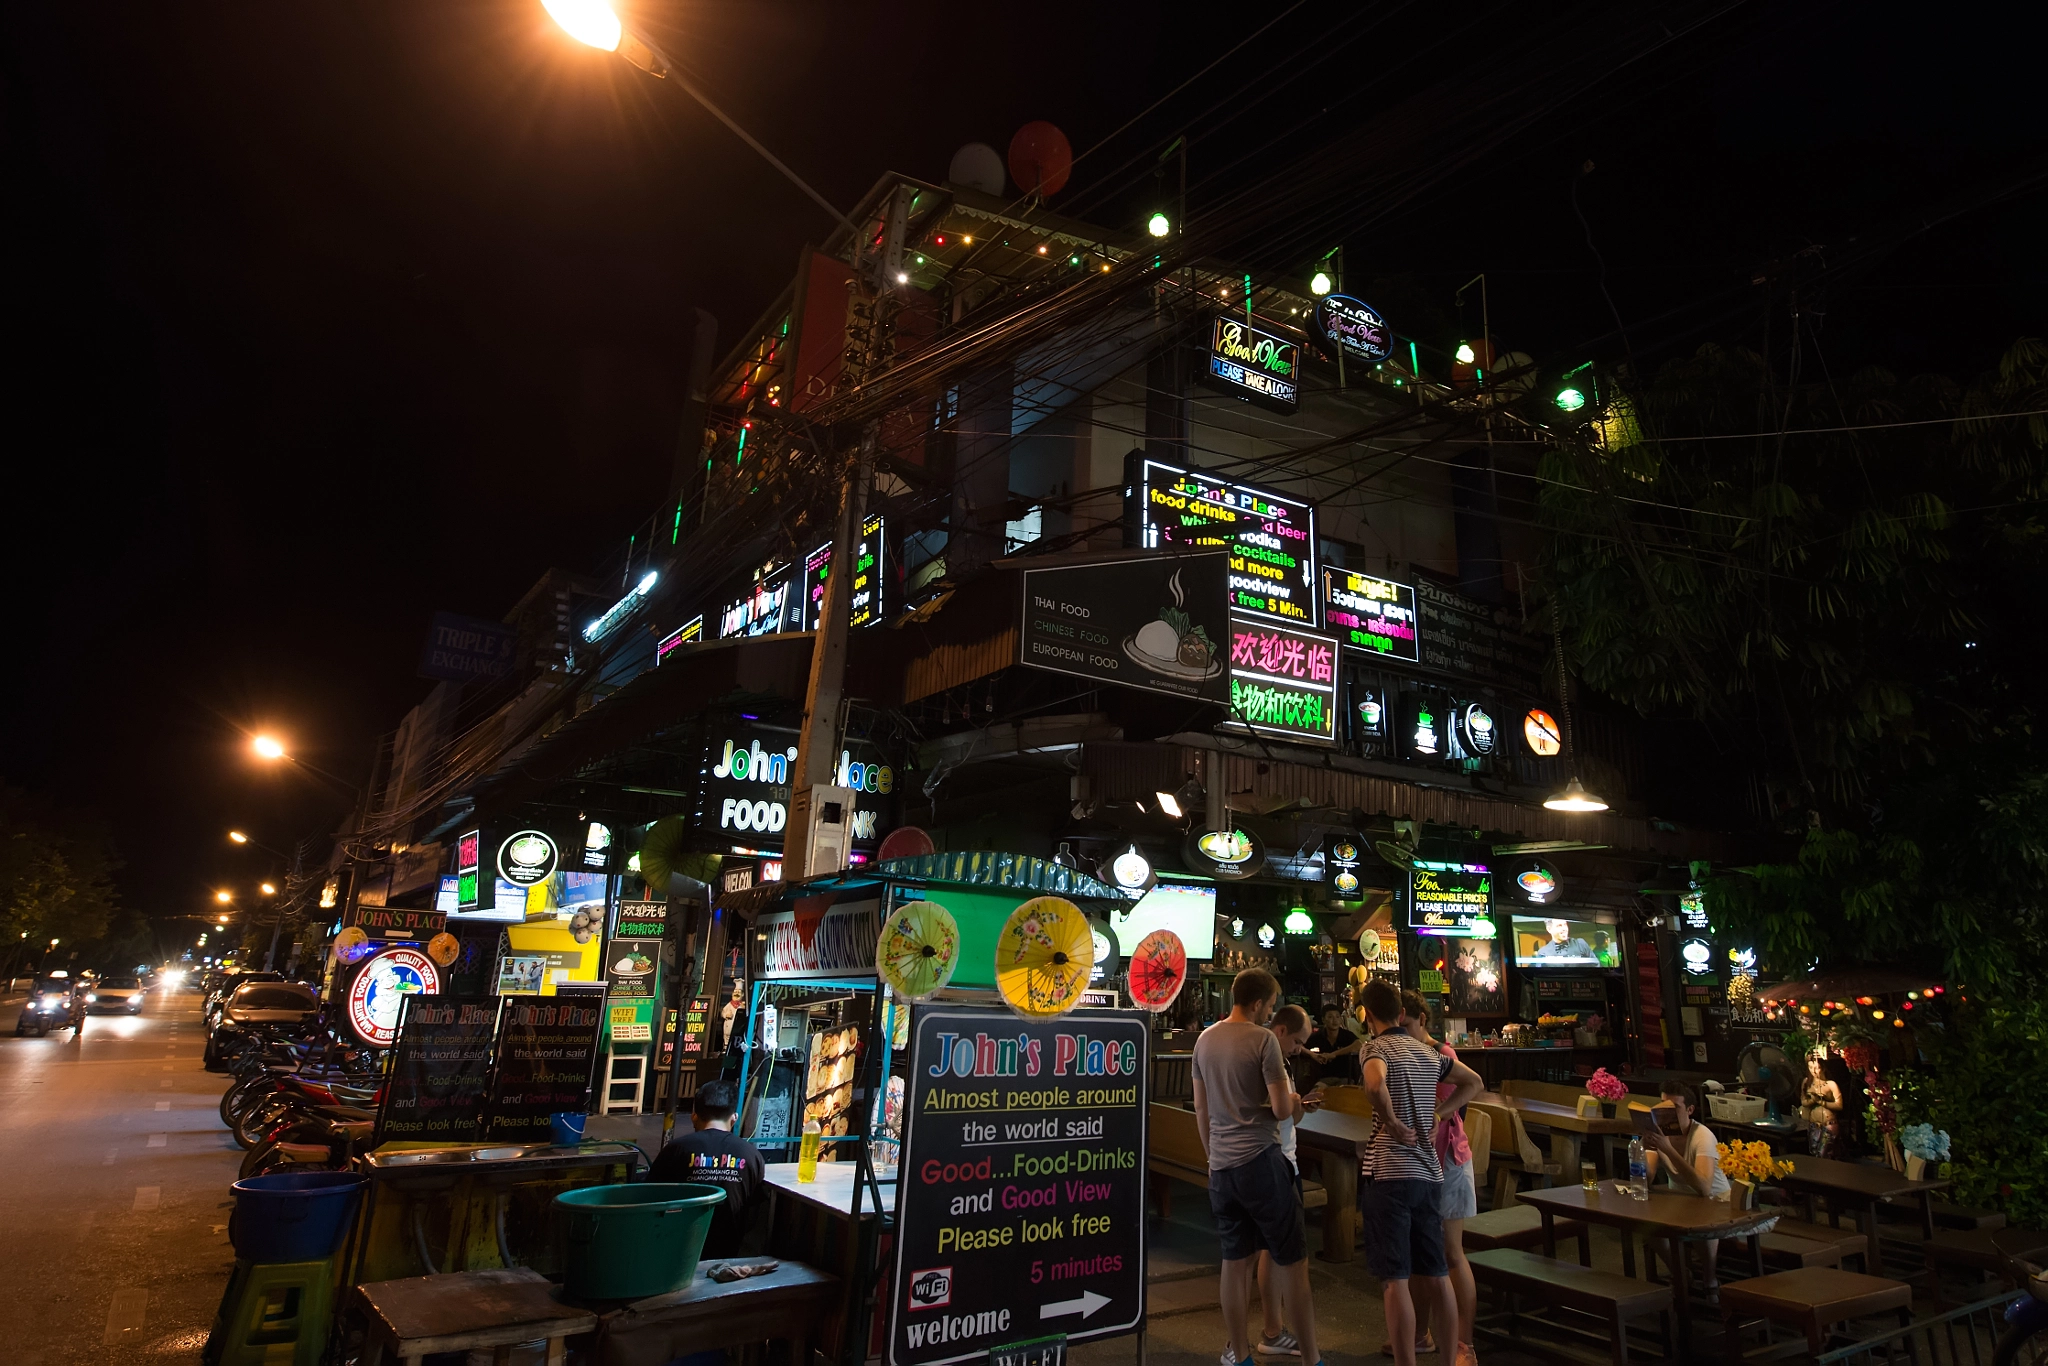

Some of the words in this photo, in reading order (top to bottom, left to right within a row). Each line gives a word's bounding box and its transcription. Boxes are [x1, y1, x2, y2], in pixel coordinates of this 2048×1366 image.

[1357, 324, 1382, 343] View
[1218, 323, 1262, 363] Good
[1258, 339, 1292, 375] View
[1212, 359, 1244, 383] PLEASE
[1244, 370, 1265, 391] TAKE
[1265, 380, 1272, 394] A
[1272, 381, 1295, 401] LOOK
[1150, 488, 1186, 509] food
[1189, 500, 1236, 522] drinks
[1173, 478, 1236, 505] John's
[1240, 494, 1287, 518] Place
[1239, 532, 1281, 549] vodka
[1277, 522, 1307, 541] beer
[1233, 544, 1296, 568] cocktails
[1248, 562, 1284, 580] more
[1034, 596, 1055, 611] THAI
[1061, 602, 1090, 618] FOOD
[1238, 591, 1265, 609] free
[1268, 598, 1276, 612] 5
[1279, 598, 1307, 618] Min.
[437, 626, 497, 654] TRIPLE
[1033, 619, 1075, 638] CHINESE
[1080, 630, 1109, 645] FOOD
[1350, 630, 1393, 654] ราคาถูก
[1032, 642, 1084, 663] EUROPEAN
[1089, 654, 1119, 670] FOOD
[1231, 631, 1332, 683] 欢迎光临
[713, 738, 799, 786] John'
[837, 749, 894, 795] lace
[720, 798, 787, 833] FOOD
[1416, 891, 1463, 902] REASONABLE
[1463, 893, 1488, 904] PRICES
[1416, 902, 1443, 912] PLEASE
[1444, 903, 1463, 913] LOOK
[356, 910, 404, 928] JOHN'S
[405, 913, 446, 930] PLACE
[395, 953, 424, 968] QUALITY
[420, 965, 435, 986] FOOD
[1420, 971, 1442, 982] WI-FI
[355, 976, 370, 998] FOOD
[1421, 980, 1441, 991] FREE
[408, 1003, 455, 1025] John's
[458, 1004, 497, 1025] Place
[510, 1004, 557, 1027] John's
[558, 1005, 598, 1027] Place
[613, 1008, 635, 1016] WIFI
[687, 1022, 705, 1033] VIEW
[403, 1034, 432, 1044] Almost
[434, 1035, 462, 1045] people
[463, 1034, 491, 1044] around
[508, 1033, 536, 1043] Almost
[537, 1034, 564, 1045] people
[565, 1033, 593, 1043] around
[684, 1042, 702, 1052] LOOK
[409, 1051, 427, 1060] the
[430, 1050, 460, 1060] world
[463, 1049, 485, 1060] said
[514, 1048, 531, 1058] the
[534, 1048, 563, 1058] world
[565, 1048, 587, 1058] said
[929, 1032, 1041, 1078] John's
[1053, 1033, 1137, 1077] Place
[395, 1096, 416, 1109] and
[419, 1095, 446, 1109] Good
[449, 1094, 473, 1107] View
[502, 1093, 522, 1104] and
[524, 1093, 551, 1105] Good
[554, 1092, 578, 1104] View
[923, 1088, 999, 1110] Almost
[1006, 1085, 1071, 1110] people
[1076, 1084, 1137, 1106] around
[384, 1119, 424, 1132] Please
[427, 1118, 451, 1131] look
[453, 1117, 476, 1130] free
[492, 1115, 530, 1127] Please
[962, 1120, 997, 1142] the
[1005, 1117, 1059, 1141] world
[1065, 1116, 1104, 1138] said
[688, 1152, 719, 1168] John's
[720, 1153, 746, 1169] Place
[950, 1187, 993, 1216] and
[1001, 1183, 1057, 1210] Good
[1065, 1180, 1112, 1205] View
[937, 1226, 1014, 1255] Please
[1021, 1216, 1064, 1244] look
[1071, 1214, 1112, 1238] free
[1031, 1260, 1043, 1284] 5
[1051, 1253, 1123, 1281] minutes
[906, 1307, 1011, 1350] welcome
